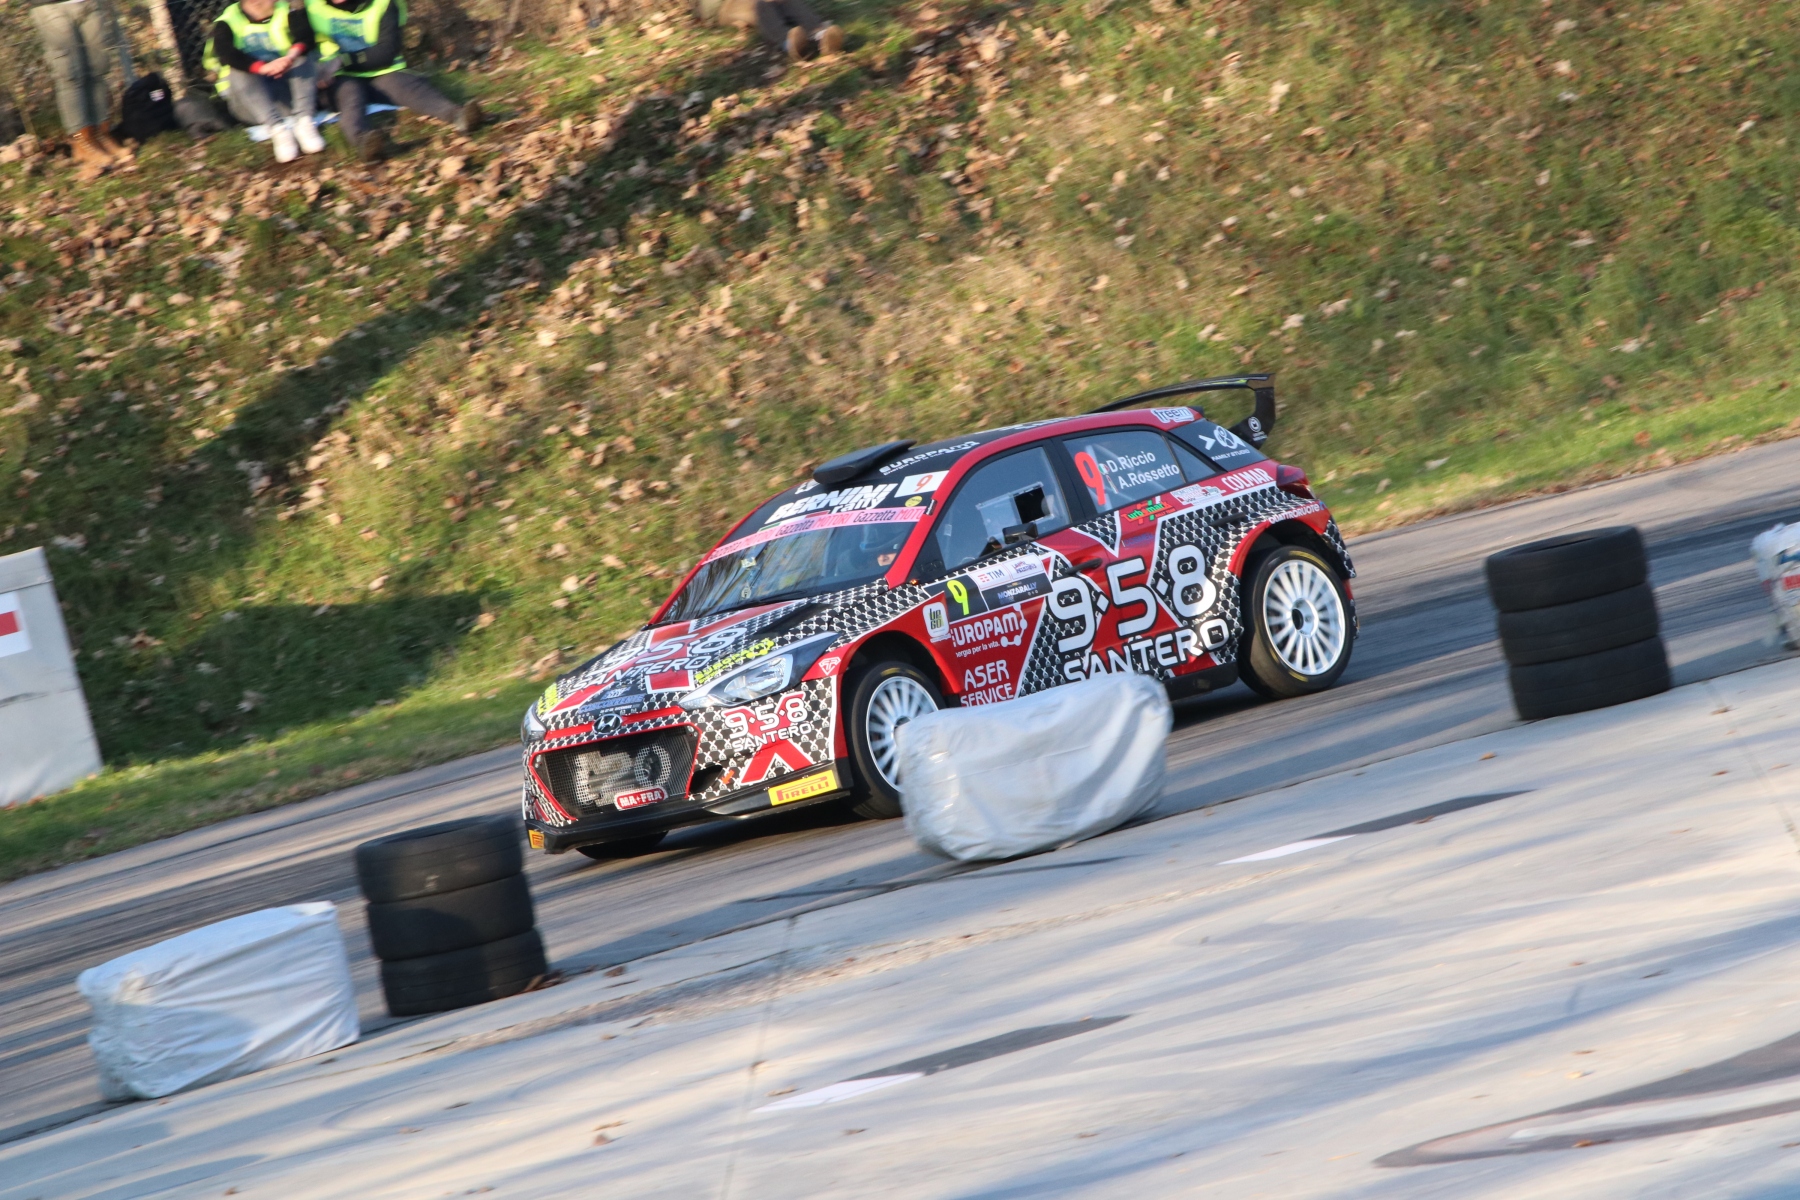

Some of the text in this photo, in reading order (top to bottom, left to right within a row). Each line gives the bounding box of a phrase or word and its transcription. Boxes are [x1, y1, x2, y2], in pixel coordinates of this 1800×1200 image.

[1153, 407, 1192, 421] freem
[1106, 451, 1156, 473] D.Riccio
[1212, 452, 1231, 461] FAMILY
[914, 474, 933, 493] 9
[1074, 451, 1106, 506] 9
[1118, 463, 1180, 490] A.Rossetto
[1221, 467, 1274, 490] COLMAR
[764, 483, 899, 525] BERNINI
[775, 519, 815, 537] Gazzetta
[813, 512, 853, 528] MOTORI
[853, 509, 896, 523] Gazzetta
[986, 569, 1005, 580] TIM
[946, 579, 970, 616] 9
[972, 645, 982, 656] per
[1063, 618, 1230, 682] SANTERO
[572, 655, 712, 690] SANTERO
[964, 659, 1010, 692] ASER
[960, 682, 1014, 708] SERVICE
[732, 723, 812, 753] SANTERO
[776, 776, 830, 802] PIRELLI
